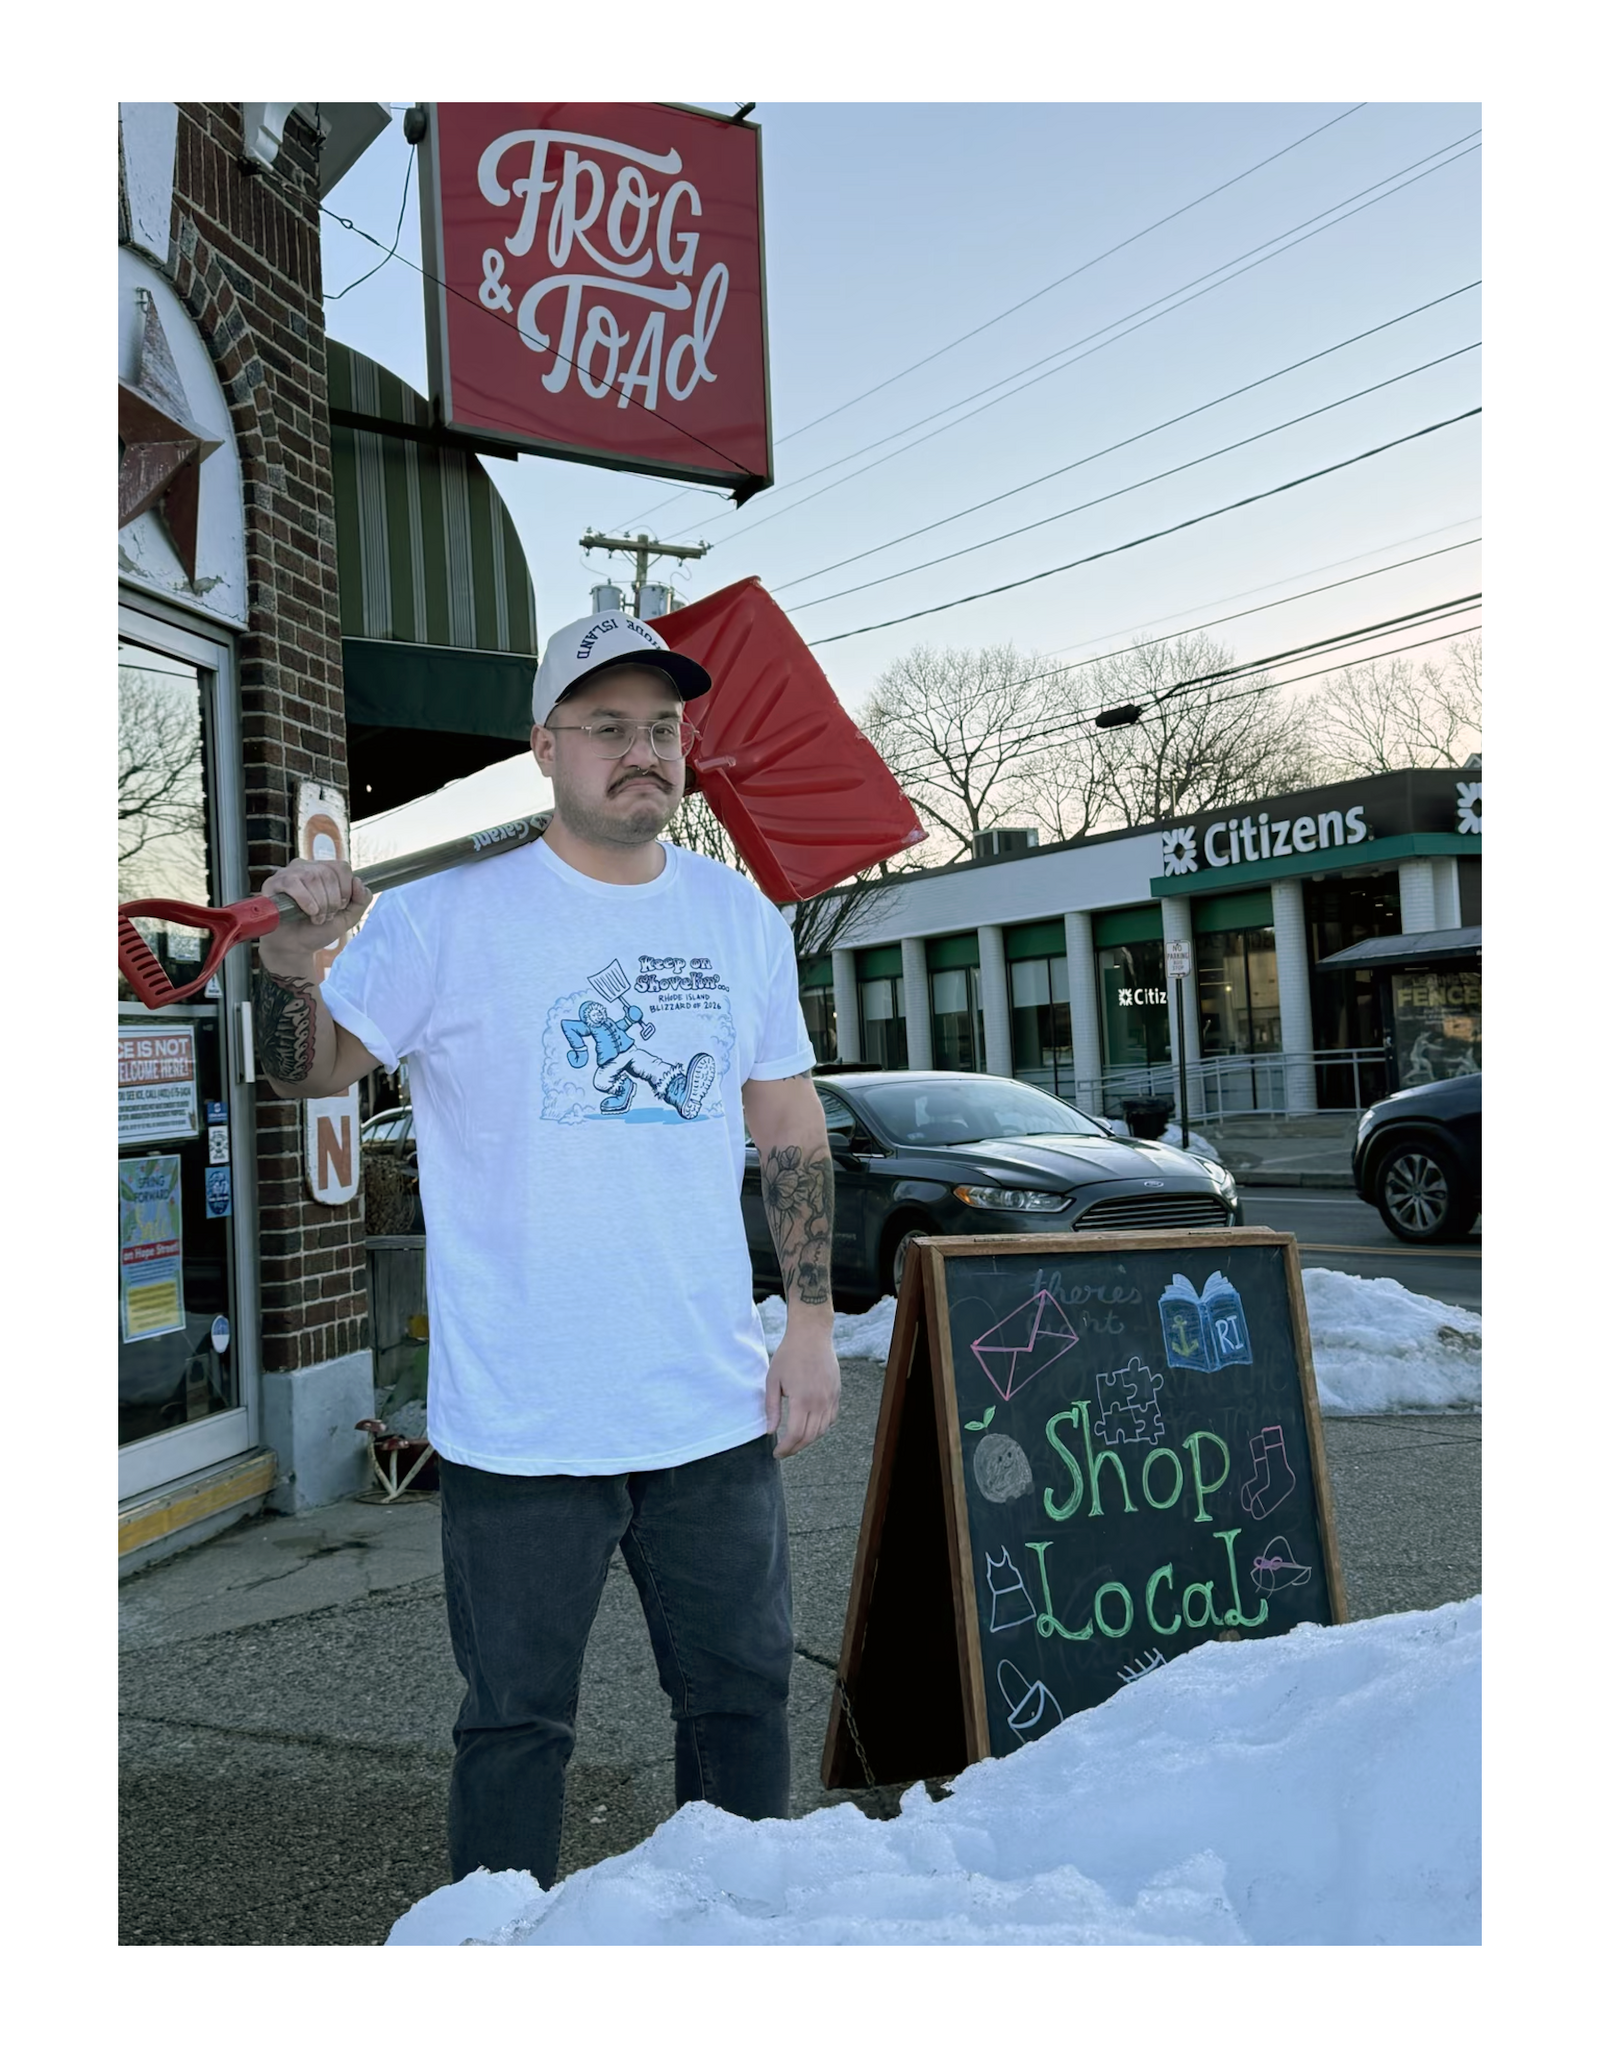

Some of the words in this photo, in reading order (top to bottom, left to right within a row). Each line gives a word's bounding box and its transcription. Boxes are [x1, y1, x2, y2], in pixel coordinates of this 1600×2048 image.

[477, 129, 702, 278] FROG
[478, 248, 513, 314] &
[576, 618, 619, 659] ISLAND
[468, 820, 530, 852] Garant
[1203, 805, 1367, 867] Citizens
[638, 955, 687, 975] Keep
[689, 957, 713, 970] on
[649, 1003, 691, 1013] BLIZZARD
[703, 1001, 722, 1010] 2026
[658, 993, 683, 1003] RHODE
[686, 993, 710, 1001] ISLAND
[137, 1040, 152, 1058] IS
[154, 1038, 189, 1057] NOT
[134, 1188, 169, 1203] FORWARD
[123, 1251, 134, 1261] on
[134, 1247, 155, 1260] Hope
[156, 1241, 178, 1256] Street
[1214, 1314, 1244, 1354] RI
[1043, 1400, 1231, 1522] Shop
